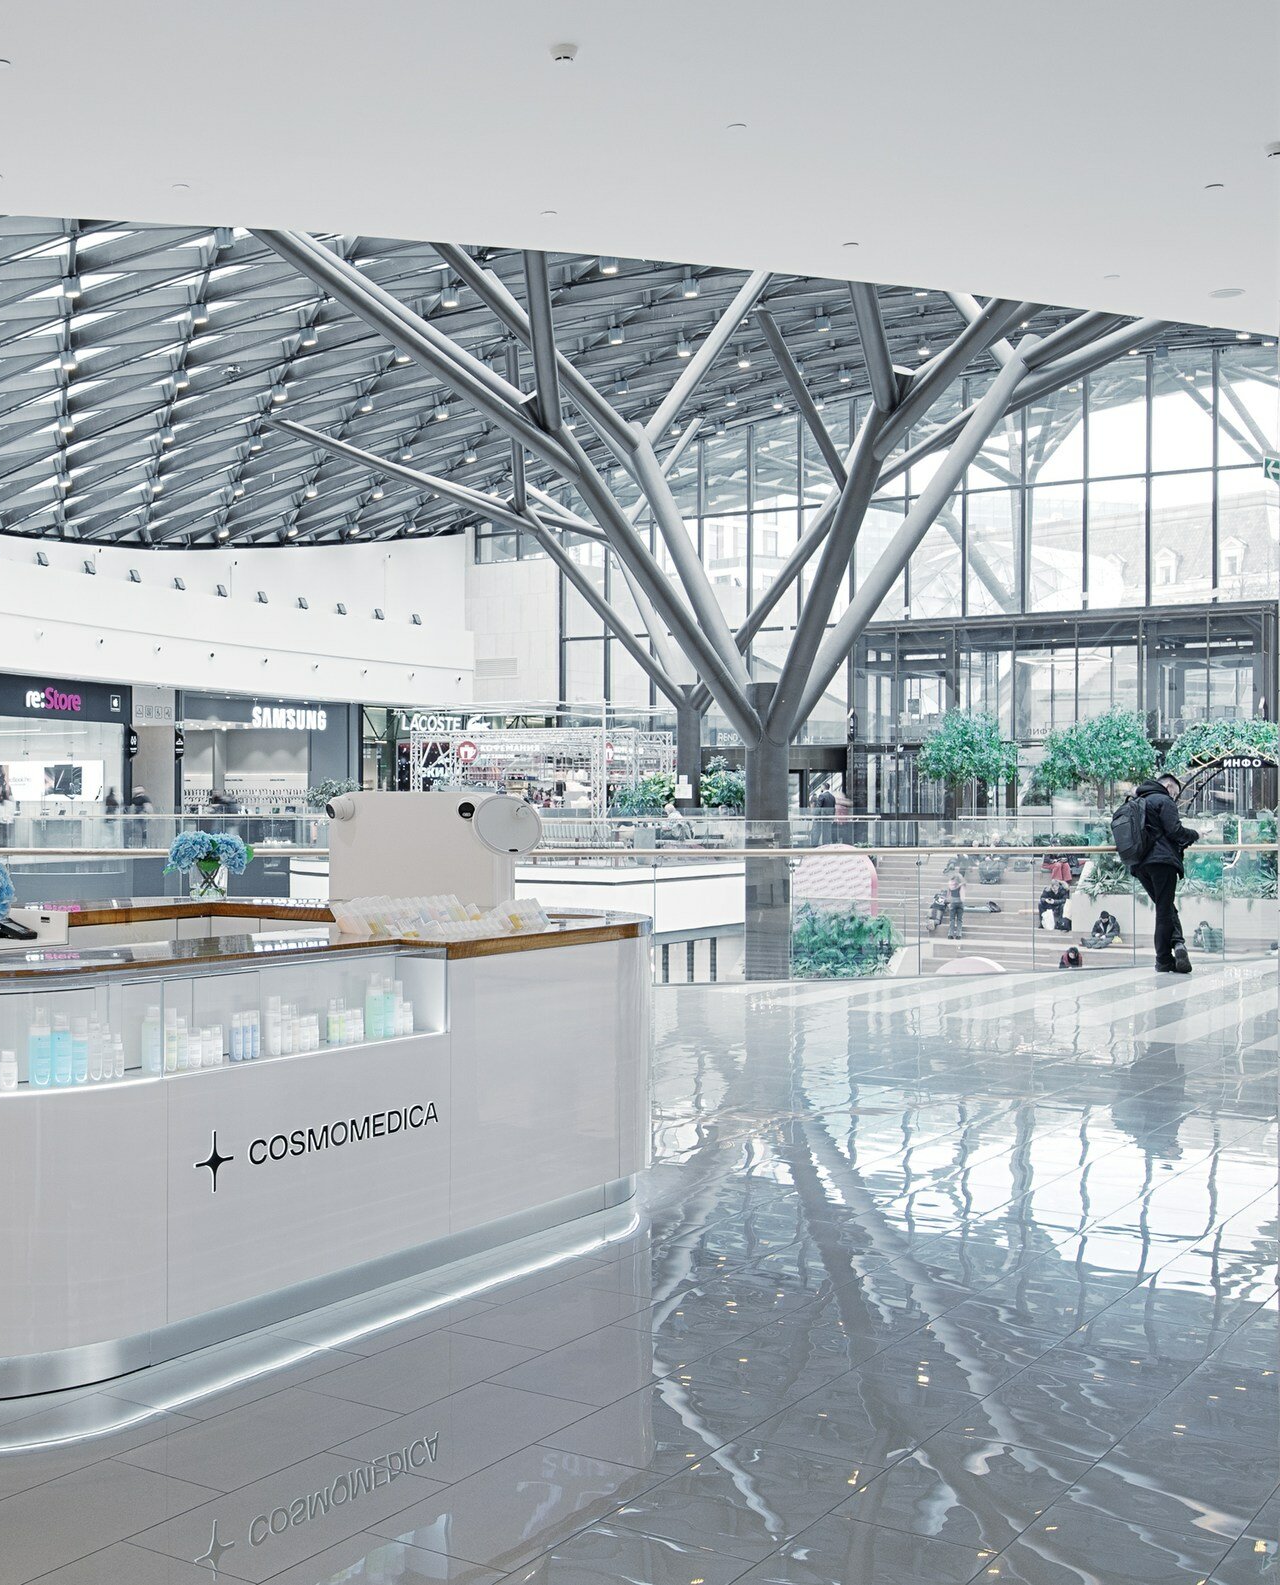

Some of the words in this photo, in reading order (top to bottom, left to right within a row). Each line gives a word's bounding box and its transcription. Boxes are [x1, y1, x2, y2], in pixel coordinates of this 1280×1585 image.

[25, 687, 82, 712] re:Store
[252, 706, 327, 731] SAMSUNG
[401, 713, 462, 732] LACOSTE
[1223, 758, 1262, 768] ИНФО
[248, 1102, 439, 1166] COSMOMEDICA
